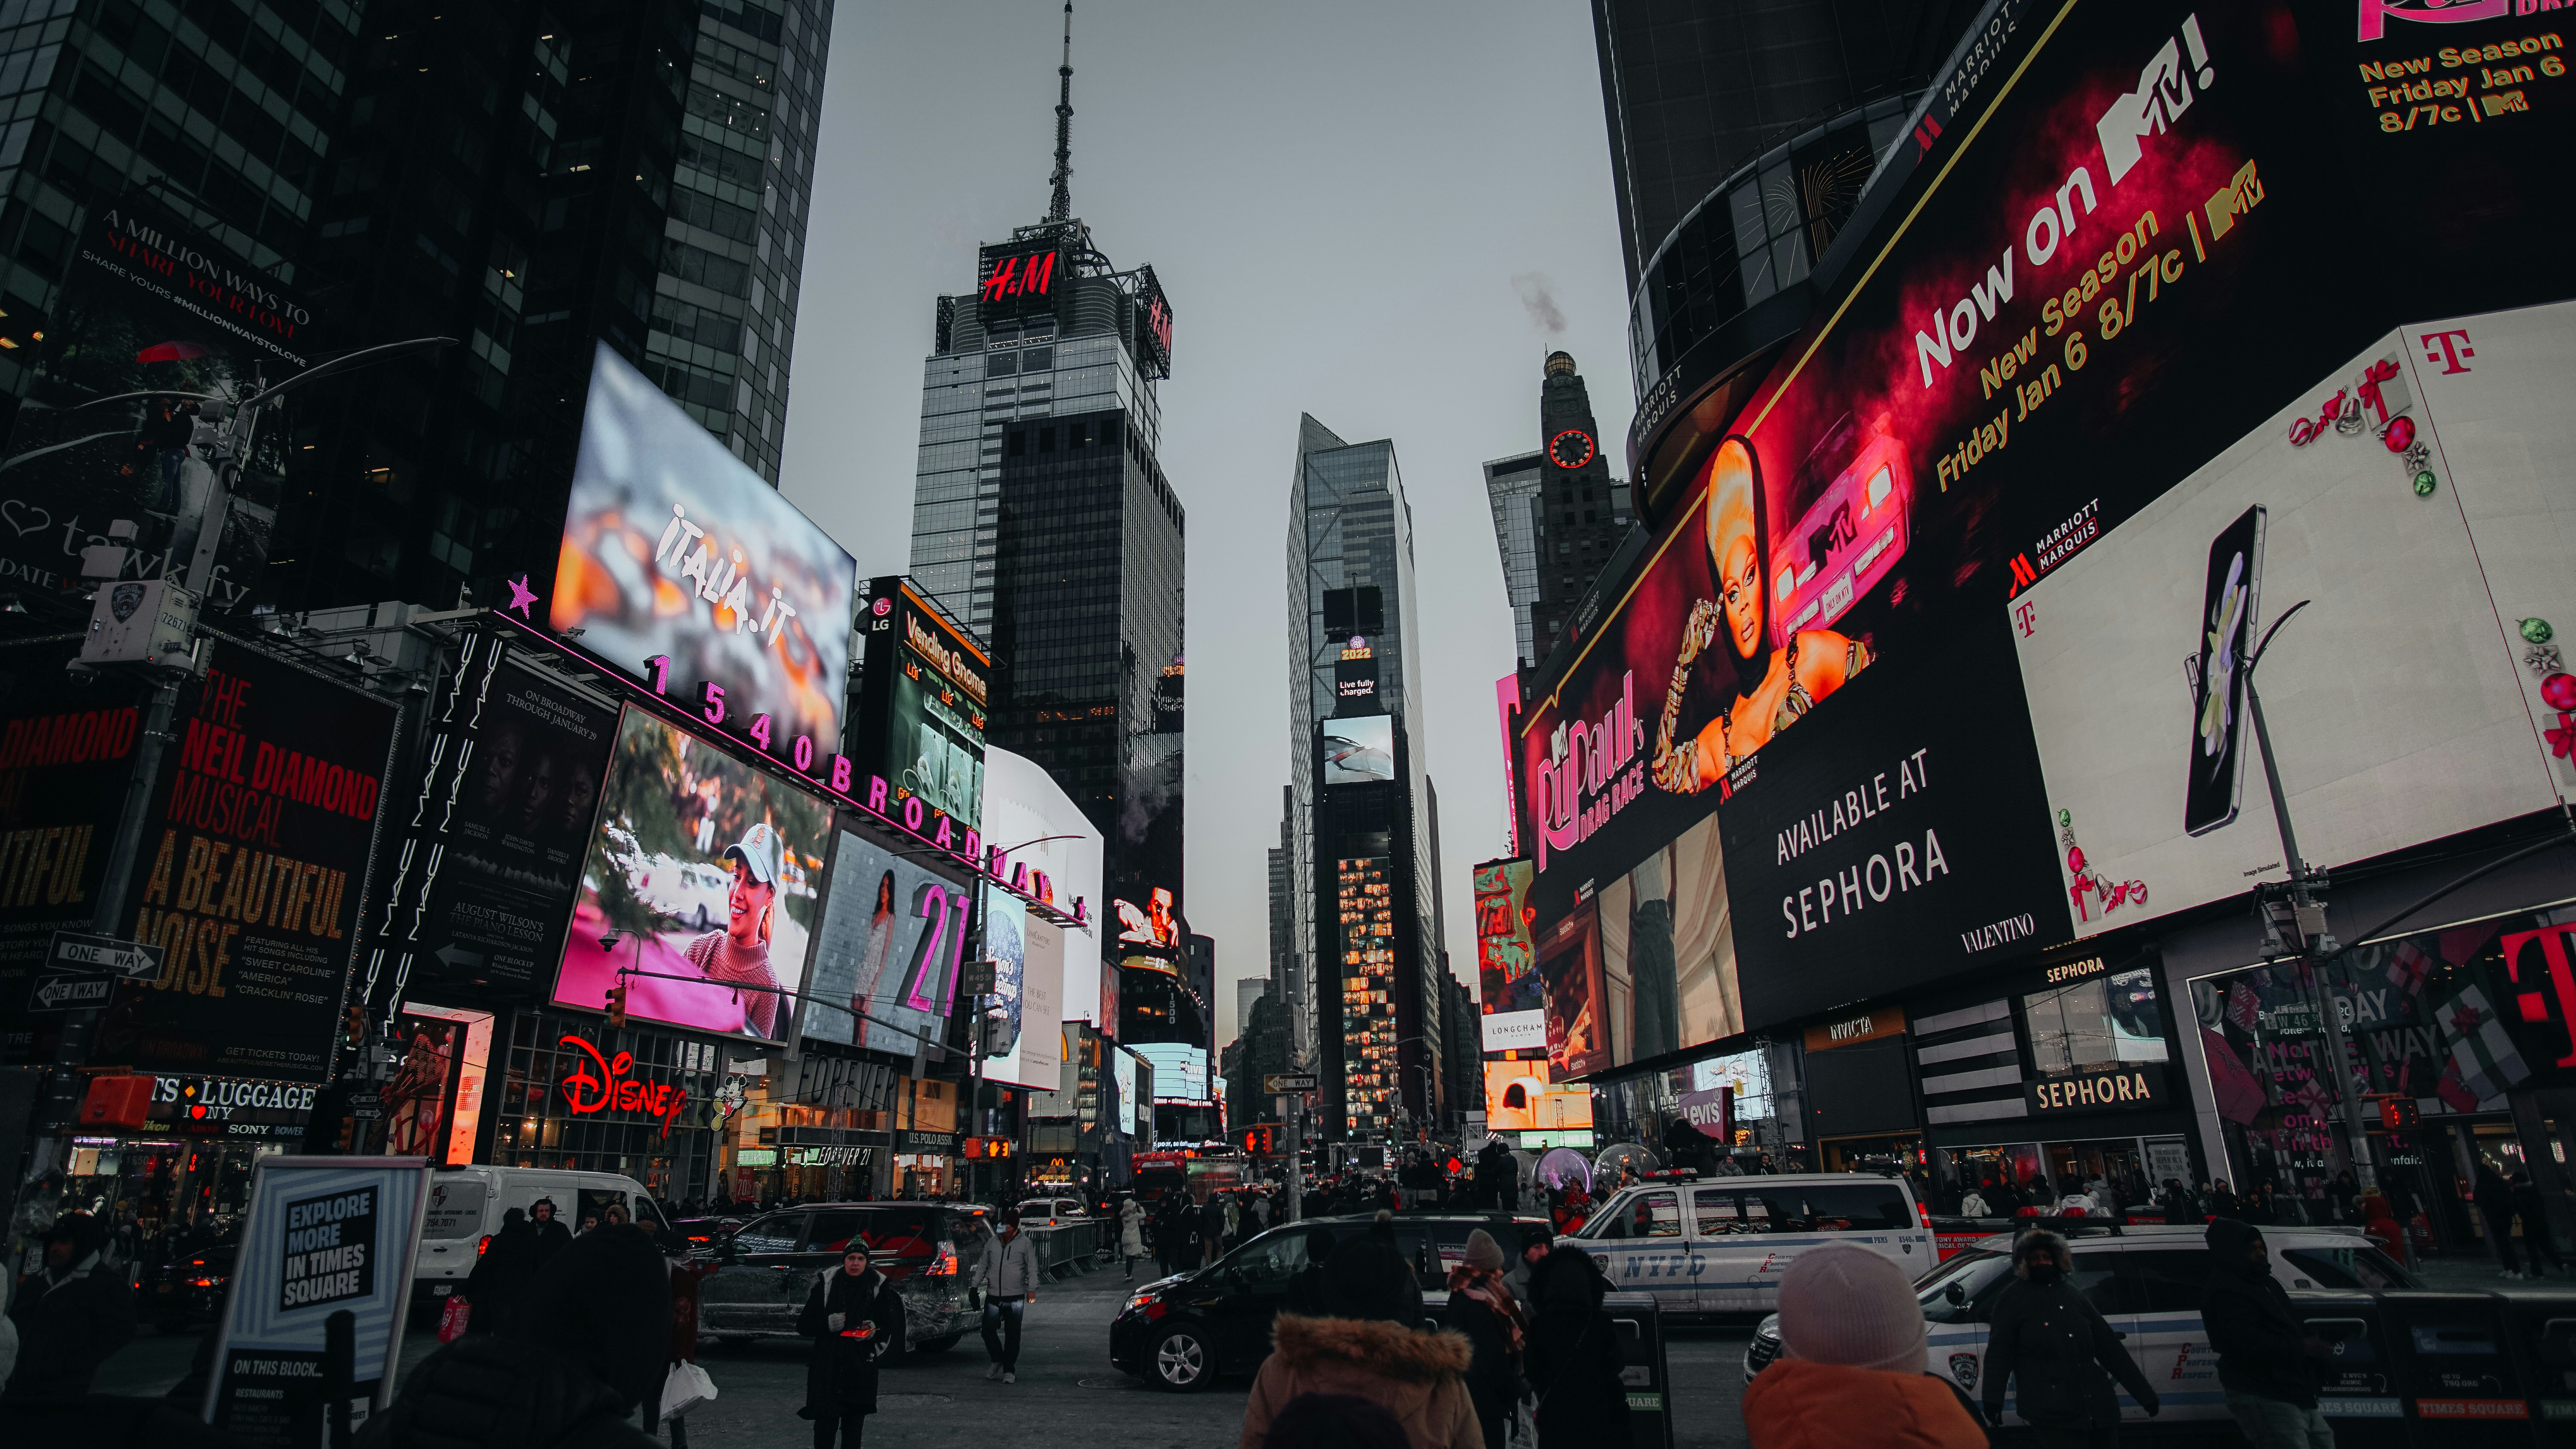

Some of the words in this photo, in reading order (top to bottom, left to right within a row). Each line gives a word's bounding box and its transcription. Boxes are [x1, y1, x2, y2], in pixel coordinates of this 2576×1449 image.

[2360, 57, 2430, 82] New
[2439, 32, 2563, 67] Season
[2368, 76, 2469, 108] Friday
[2481, 65, 2534, 88] Jan
[2540, 56, 2565, 76] 6
[2380, 105, 2461, 133] 8/7c
[2481, 91, 2529, 117] MTV
[103, 209, 118, 228] A
[126, 219, 220, 279] MILLION
[226, 270, 278, 310] WAYS
[285, 301, 309, 324] TO
[107, 231, 175, 277] SHARE
[188, 271, 244, 314] YOUR
[983, 252, 1055, 301] H&M
[1915, 245, 2014, 388] Now
[2026, 166, 2097, 266] on
[82, 250, 126, 277] SHARE
[131, 273, 171, 299] YOURS
[173, 296, 306, 367] #MILLIONWAYSTOLOVE
[1980, 326, 2037, 400] New
[2042, 210, 2160, 337] Season
[1150, 294, 1172, 357] H&M
[1937, 407, 2008, 493] Friday
[2017, 363, 2061, 421] Jan
[2065, 332, 2087, 371] 6
[2098, 249, 2185, 340] 8/7c
[2205, 159, 2265, 241] MTV
[1635, 364, 1682, 427] MARRIOTT
[1636, 388, 1678, 449] MARQUIS
[1808, 498, 1857, 576] MTV
[2037, 498, 2099, 554] MARRIOTT
[2040, 522, 2096, 570] MARQUIS
[1578, 590, 1600, 621] MARRIOTT
[1580, 605, 1599, 636] MARQUIS
[162, 612, 187, 632] 72671
[872, 619, 889, 631] LG
[906, 611, 950, 673] Vending
[952, 652, 987, 696] Gnome
[1342, 648, 1371, 660] 2022
[198, 668, 252, 729] THE
[1340, 680, 1355, 689] Live
[1357, 679, 1373, 690] fully
[506, 693, 550, 720] THROUGH
[551, 712, 588, 737] JANUARY
[588, 730, 597, 741] 29
[526, 690, 538, 701] ON
[541, 694, 586, 724] BROADWAY
[0, 707, 138, 770] DIAMOND
[1551, 720, 1568, 768] MTV
[180, 717, 247, 786] NEIL
[251, 740, 378, 821] DIAMOND
[1731, 755, 1758, 781] MARRIOTT
[1733, 770, 1756, 792] MARQUIS
[167, 769, 283, 848] MUSICAL
[1580, 793, 1610, 843] DRAG
[1612, 760, 1644, 815] RACE
[1777, 773, 1889, 865] AVAILABLE
[1901, 748, 1927, 800] AT
[463, 828, 489, 839] JACKSON
[465, 821, 486, 832] SAMUEL
[502, 840, 535, 854] WASHINGTON
[519, 838, 535, 847] DAVID
[547, 848, 570, 859] DANIELLE
[547, 855, 566, 864] BROOKS
[2257, 861, 2280, 873] Simulated
[144, 829, 176, 903] A
[178, 835, 346, 940] BEAUTIFUL
[1783, 828, 1949, 938] SEPHORA
[3, 923, 37, 933] SONGS
[41, 922, 59, 931] YOU
[63, 920, 93, 929] KNOW
[450, 912, 471, 925] THE
[474, 918, 506, 933] PIANO
[507, 926, 544, 943] LESSON
[453, 902, 497, 920] AUGUST
[500, 912, 544, 931] WILSON'S
[246, 936, 289, 949] FEATURING
[452, 931, 476, 941] LATANYA
[477, 936, 513, 949] RICHARDSON
[1961, 913, 2035, 954] VALENTINO
[68, 945, 100, 961] ONE
[114, 952, 146, 969] WAY
[123, 907, 240, 998] NOISE
[242, 956, 280, 970] "SWEET
[283, 963, 335, 978] CAROLINE"
[258, 946, 286, 957] SONGS
[288, 951, 328, 964] INCLUDING
[238, 970, 292, 985] "AMERICA"
[2046, 956, 2105, 982] SEPHORA
[44, 986, 67, 999] ONE
[77, 983, 103, 997] WAY
[295, 992, 328, 1004] ROSIE"
[1830, 1016, 1873, 1042] INVICTA
[2278, 1016, 2288, 1027] W
[2294, 1015, 2308, 1026] 46
[226, 1047, 245, 1055] GET
[248, 1049, 286, 1059] TICKETS
[289, 1053, 319, 1063] TODAY!
[200, 1081, 316, 1110] LUGGAGE
[796, 1053, 898, 1111] FOREVER
[2036, 1072, 2151, 1109] SEPHORA
[207, 1107, 233, 1120] NY
[228, 1125, 271, 1135] SONY
[274, 1126, 304, 1137] BOWER
[909, 1133, 919, 1143] U.S.
[921, 1133, 936, 1144] POLO
[937, 1134, 953, 1145] ASSN.
[860, 1149, 872, 1165] 21
[289, 1192, 370, 1230] EXPLORE
[288, 1223, 341, 1255] MORE
[287, 1256, 306, 1280] IN
[310, 1243, 365, 1276] TIMES
[1625, 1255, 1706, 1277] NYPD
[285, 1270, 359, 1306] SQUARE
[234, 1359, 251, 1374] ON
[253, 1360, 279, 1375] THIS
[279, 1361, 323, 1377] BLOCK...
[236, 1388, 284, 1400] RESTAURANTS
[2346, 1403, 2399, 1413] SQUARE
[2420, 1404, 2464, 1414] TIMES
[2468, 1404, 2524, 1415] SQUARE
